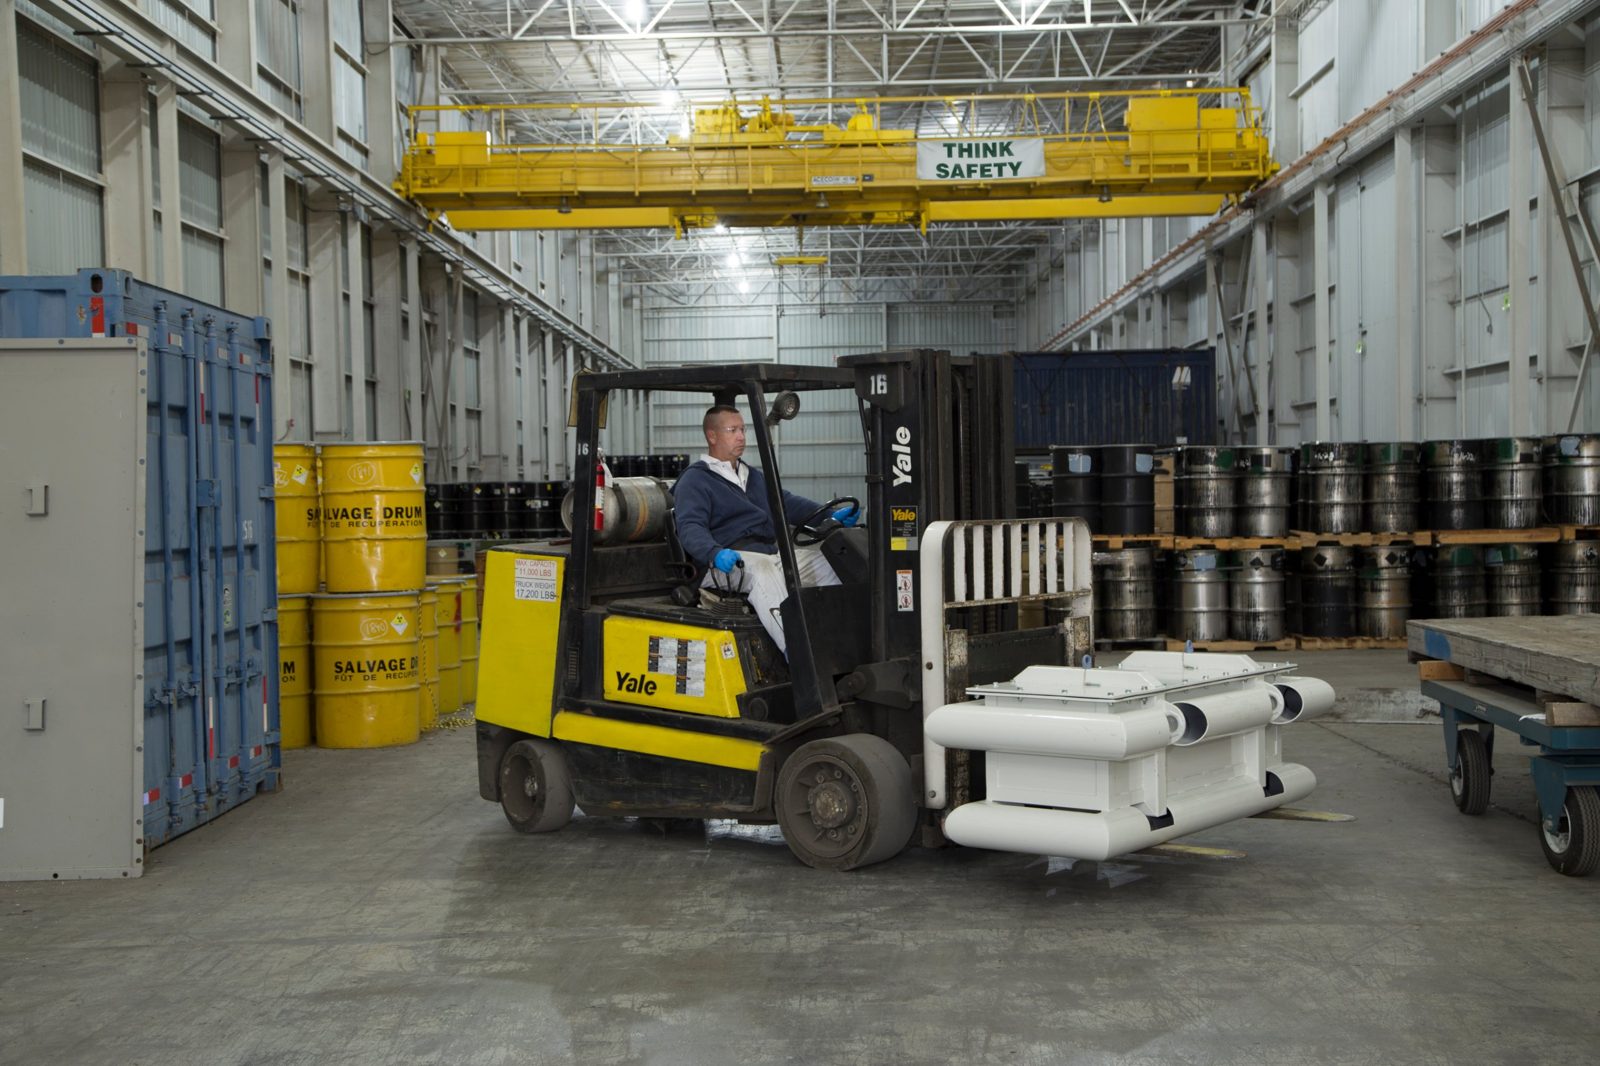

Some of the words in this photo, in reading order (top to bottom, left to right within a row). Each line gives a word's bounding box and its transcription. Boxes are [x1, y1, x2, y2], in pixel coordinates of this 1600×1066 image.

[943, 141, 1014, 158] THINK
[936, 161, 1022, 179] SAFETY
[870, 374, 887, 395] 16
[578, 443, 589, 456] 16
[892, 426, 912, 487] Yale
[383, 505, 422, 519] DRUM
[892, 508, 916, 521] Yale
[529, 560, 555, 568] CAPACITY
[540, 569, 551, 577] LBS
[515, 580, 533, 588] TRUCK
[534, 582, 556, 590] WEIGHT
[540, 590, 555, 600] LBS
[334, 658, 406, 673] SALVAGE
[616, 671, 657, 696] Yale
